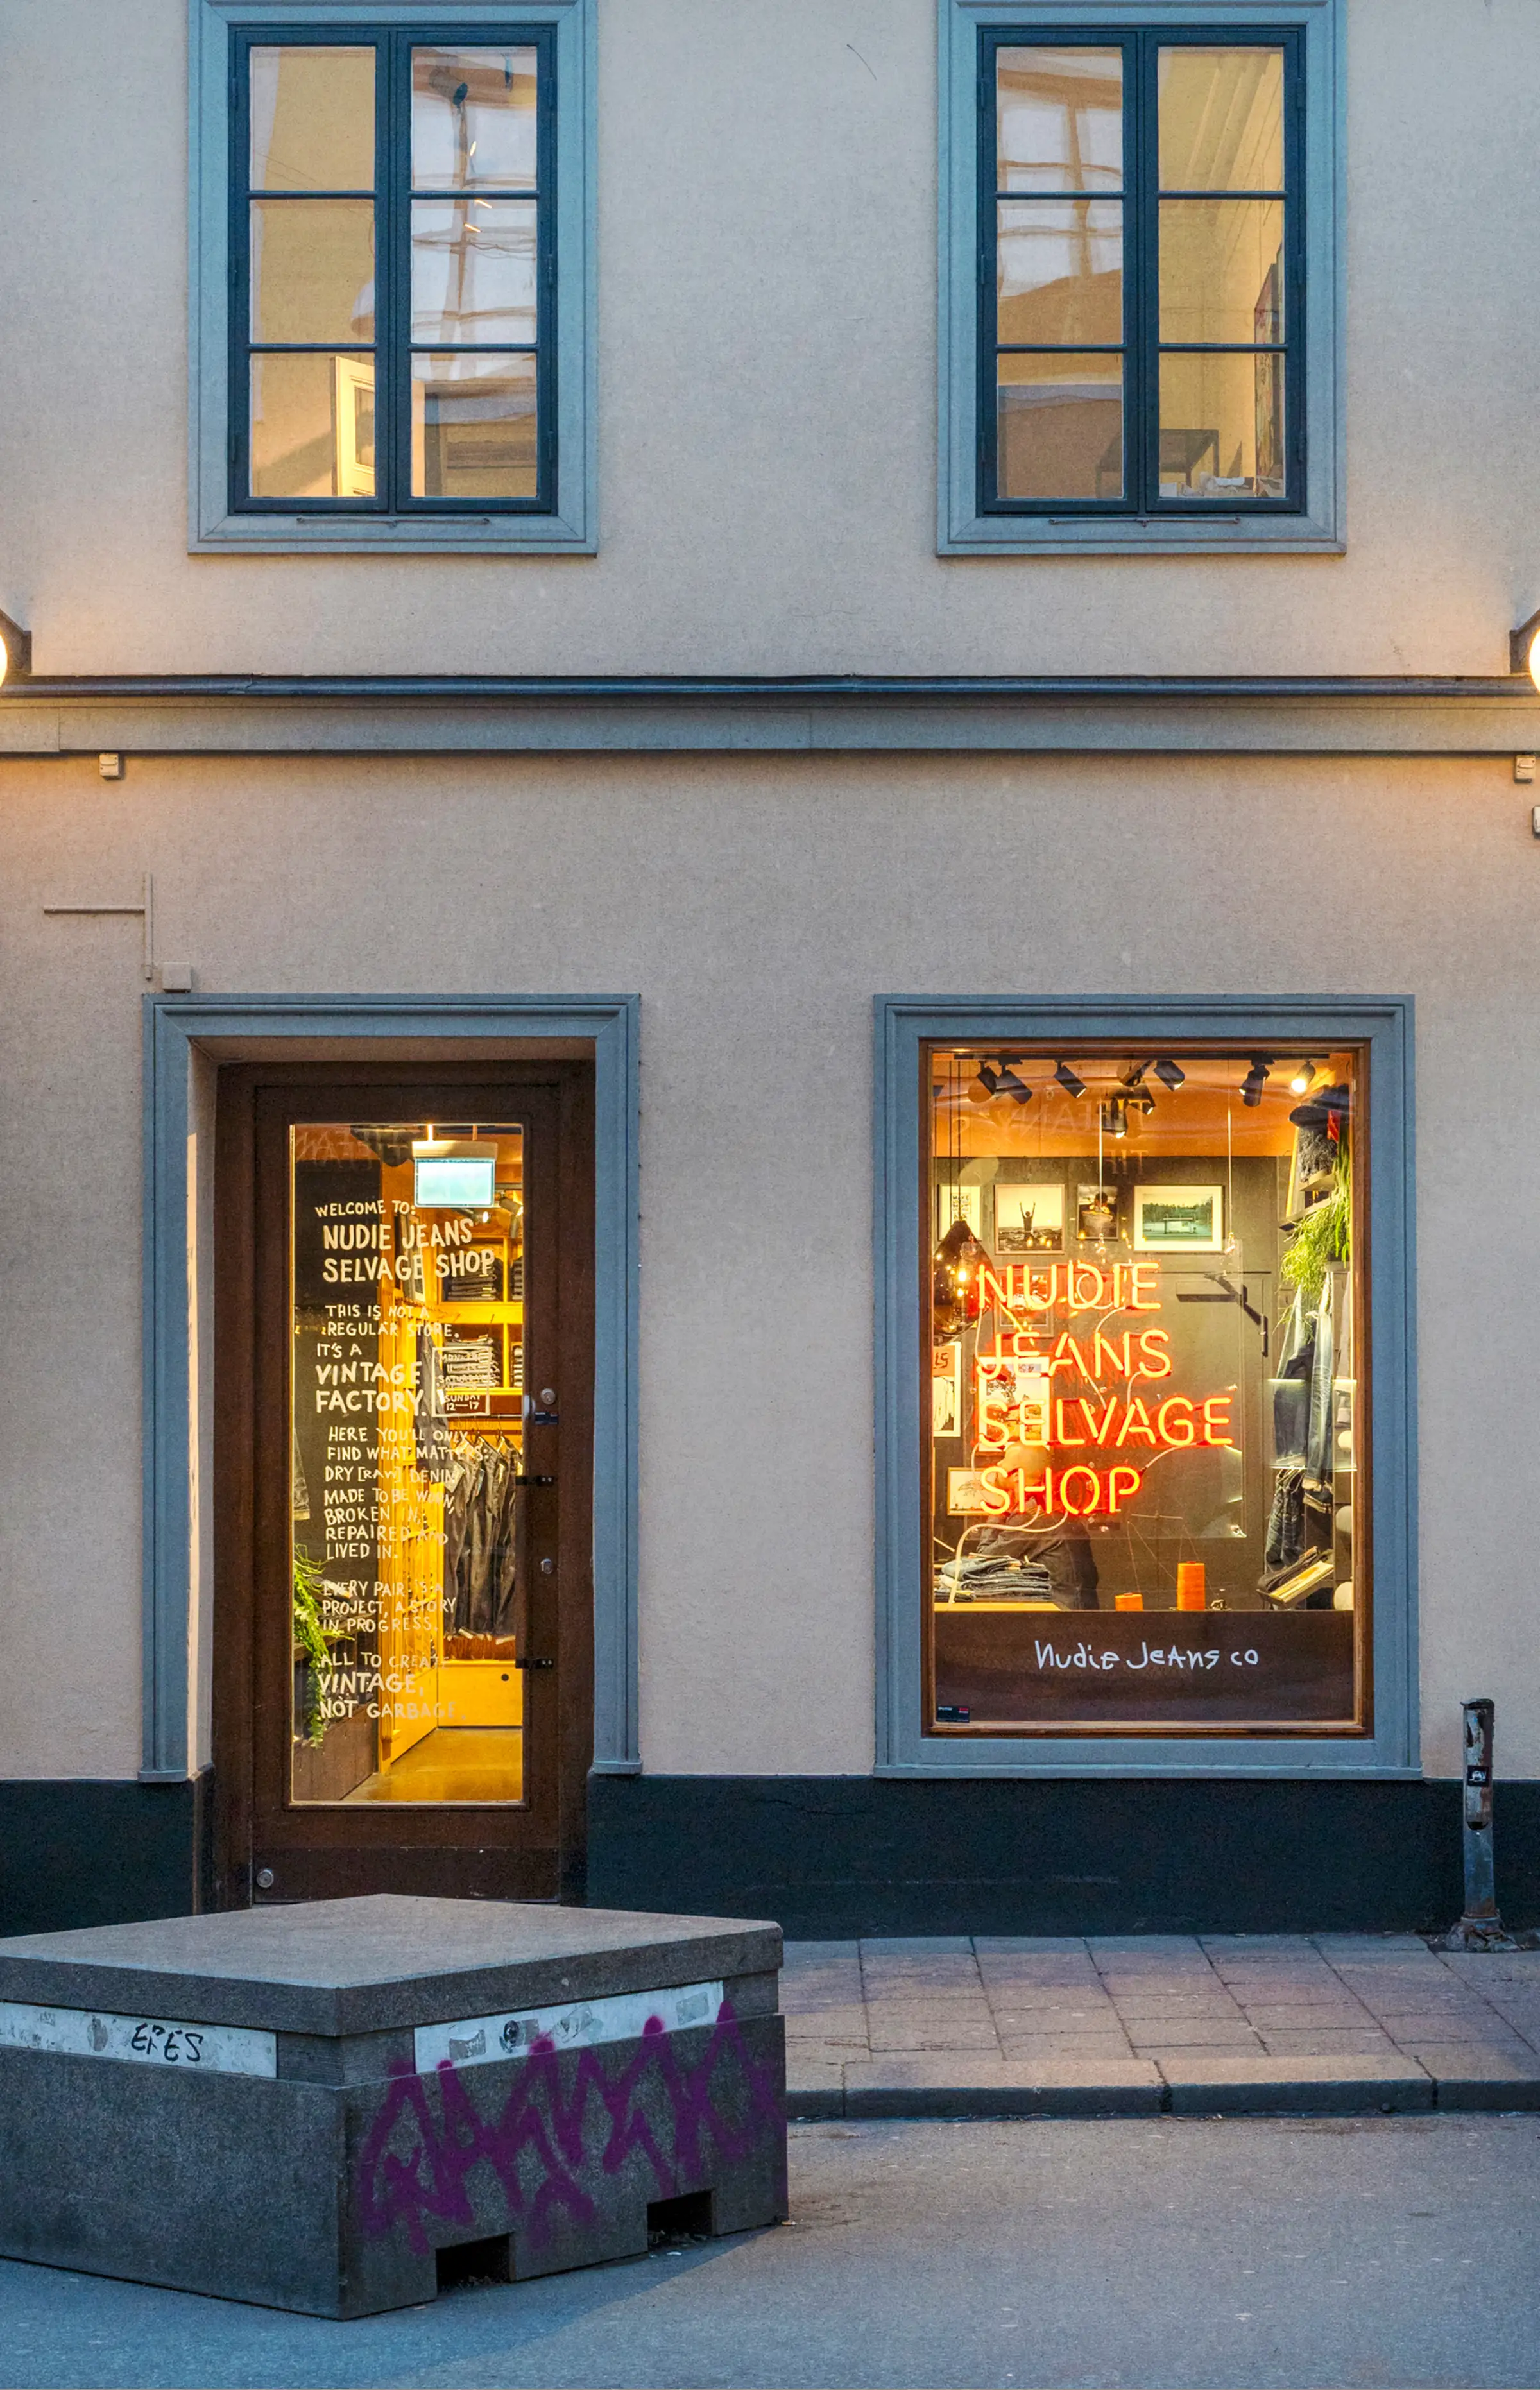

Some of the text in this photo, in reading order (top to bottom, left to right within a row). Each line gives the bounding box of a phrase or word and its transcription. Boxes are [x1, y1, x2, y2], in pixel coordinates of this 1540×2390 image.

[315, 1200, 416, 1217] WELCOME TO:
[323, 1218, 474, 1250] NUDIE JEANS
[322, 1249, 495, 1283] SELVAGE SHOP
[978, 1261, 1162, 1310] NUDIE
[325, 1304, 430, 1319] THIS IS NOT A
[327, 1322, 459, 1338] REGULAR STORE.
[317, 1342, 363, 1358] IT'S A
[976, 1328, 1172, 1379] JEANS
[315, 1361, 423, 1385] VINTAGE
[316, 1389, 427, 1417] FACTORY.
[445, 1394, 481, 1403] SUNDAY
[979, 1396, 1233, 1447] SELVAGE
[329, 1426, 468, 1443] HERE YOU'LL ONLY
[327, 1446, 361, 1461] FIND
[367, 1446, 411, 1461] WHAT
[325, 1465, 354, 1482] DRY
[324, 1489, 365, 1507] MADE
[372, 1487, 389, 1503] TO
[392, 1489, 409, 1504] BE
[979, 1465, 1141, 1515] SHOP
[324, 1506, 390, 1526] BROKEN
[325, 1524, 449, 1546] REPAIRED AND
[326, 1542, 398, 1560] LIVED IN.
[323, 1580, 368, 1597] EVERY
[374, 1581, 405, 1597] PAIR
[322, 1597, 457, 1618] PROJECT, A STORY
[323, 1617, 438, 1632] IN PROGRESS.
[321, 1652, 449, 1669] ALL TO CREATE
[1034, 1640, 1120, 1669] Nudie
[318, 1671, 424, 1696] VINTAGE,
[320, 1700, 466, 1720] NOT GARBAGE.
